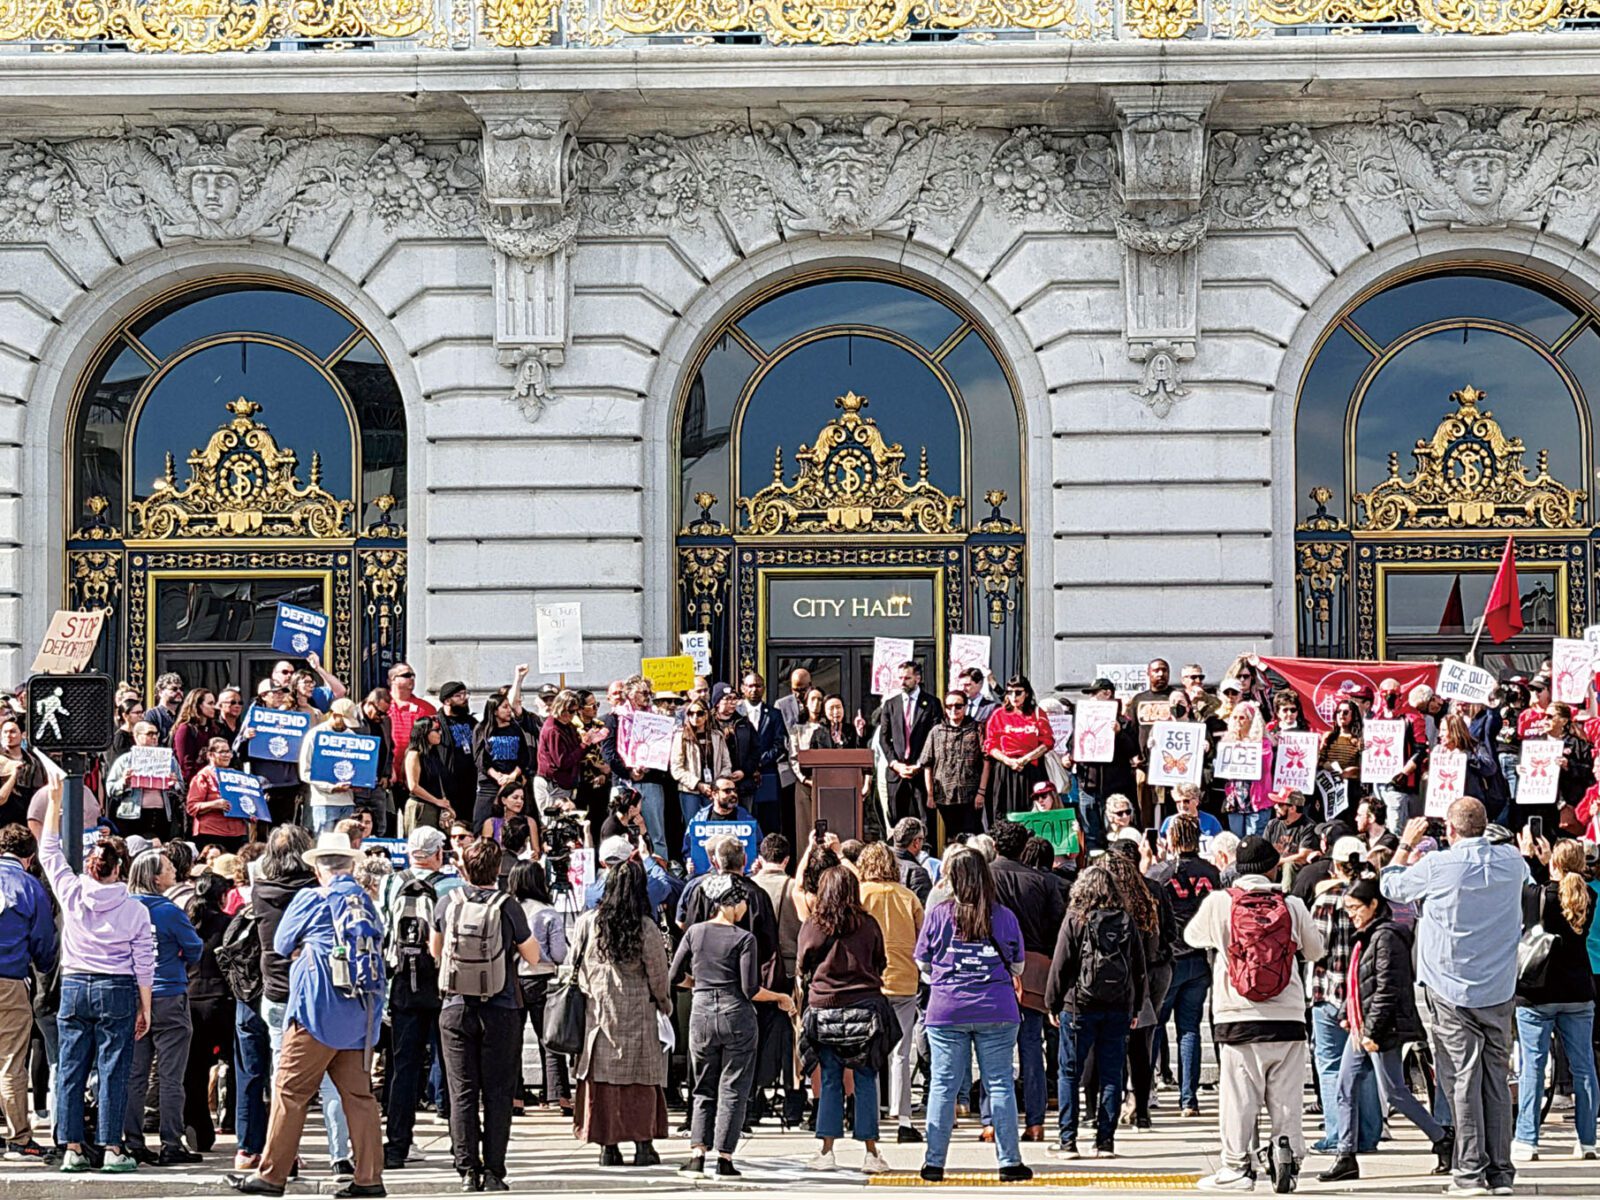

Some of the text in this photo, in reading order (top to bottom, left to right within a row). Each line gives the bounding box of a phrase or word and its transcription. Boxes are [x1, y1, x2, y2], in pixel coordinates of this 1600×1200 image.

[793, 597, 911, 618] CITY HALL
[281, 605, 326, 628] DEFEND
[686, 637, 705, 648] ICE
[1125, 670, 1147, 682] ICE
[1448, 664, 1490, 686] ICE OUT
[1441, 681, 1460, 693] FOR
[254, 709, 308, 728] DEFEND
[318, 734, 376, 751] DEFEND
[1167, 730, 1192, 742] ICE
[1165, 742, 1191, 751] OUT
[1367, 755, 1399, 766] LIVES
[1280, 765, 1311, 778] LIVES
[219, 770, 260, 789] DEFEND
[1275, 778, 1309, 788] MATTER
[694, 824, 752, 837] DEFEND
